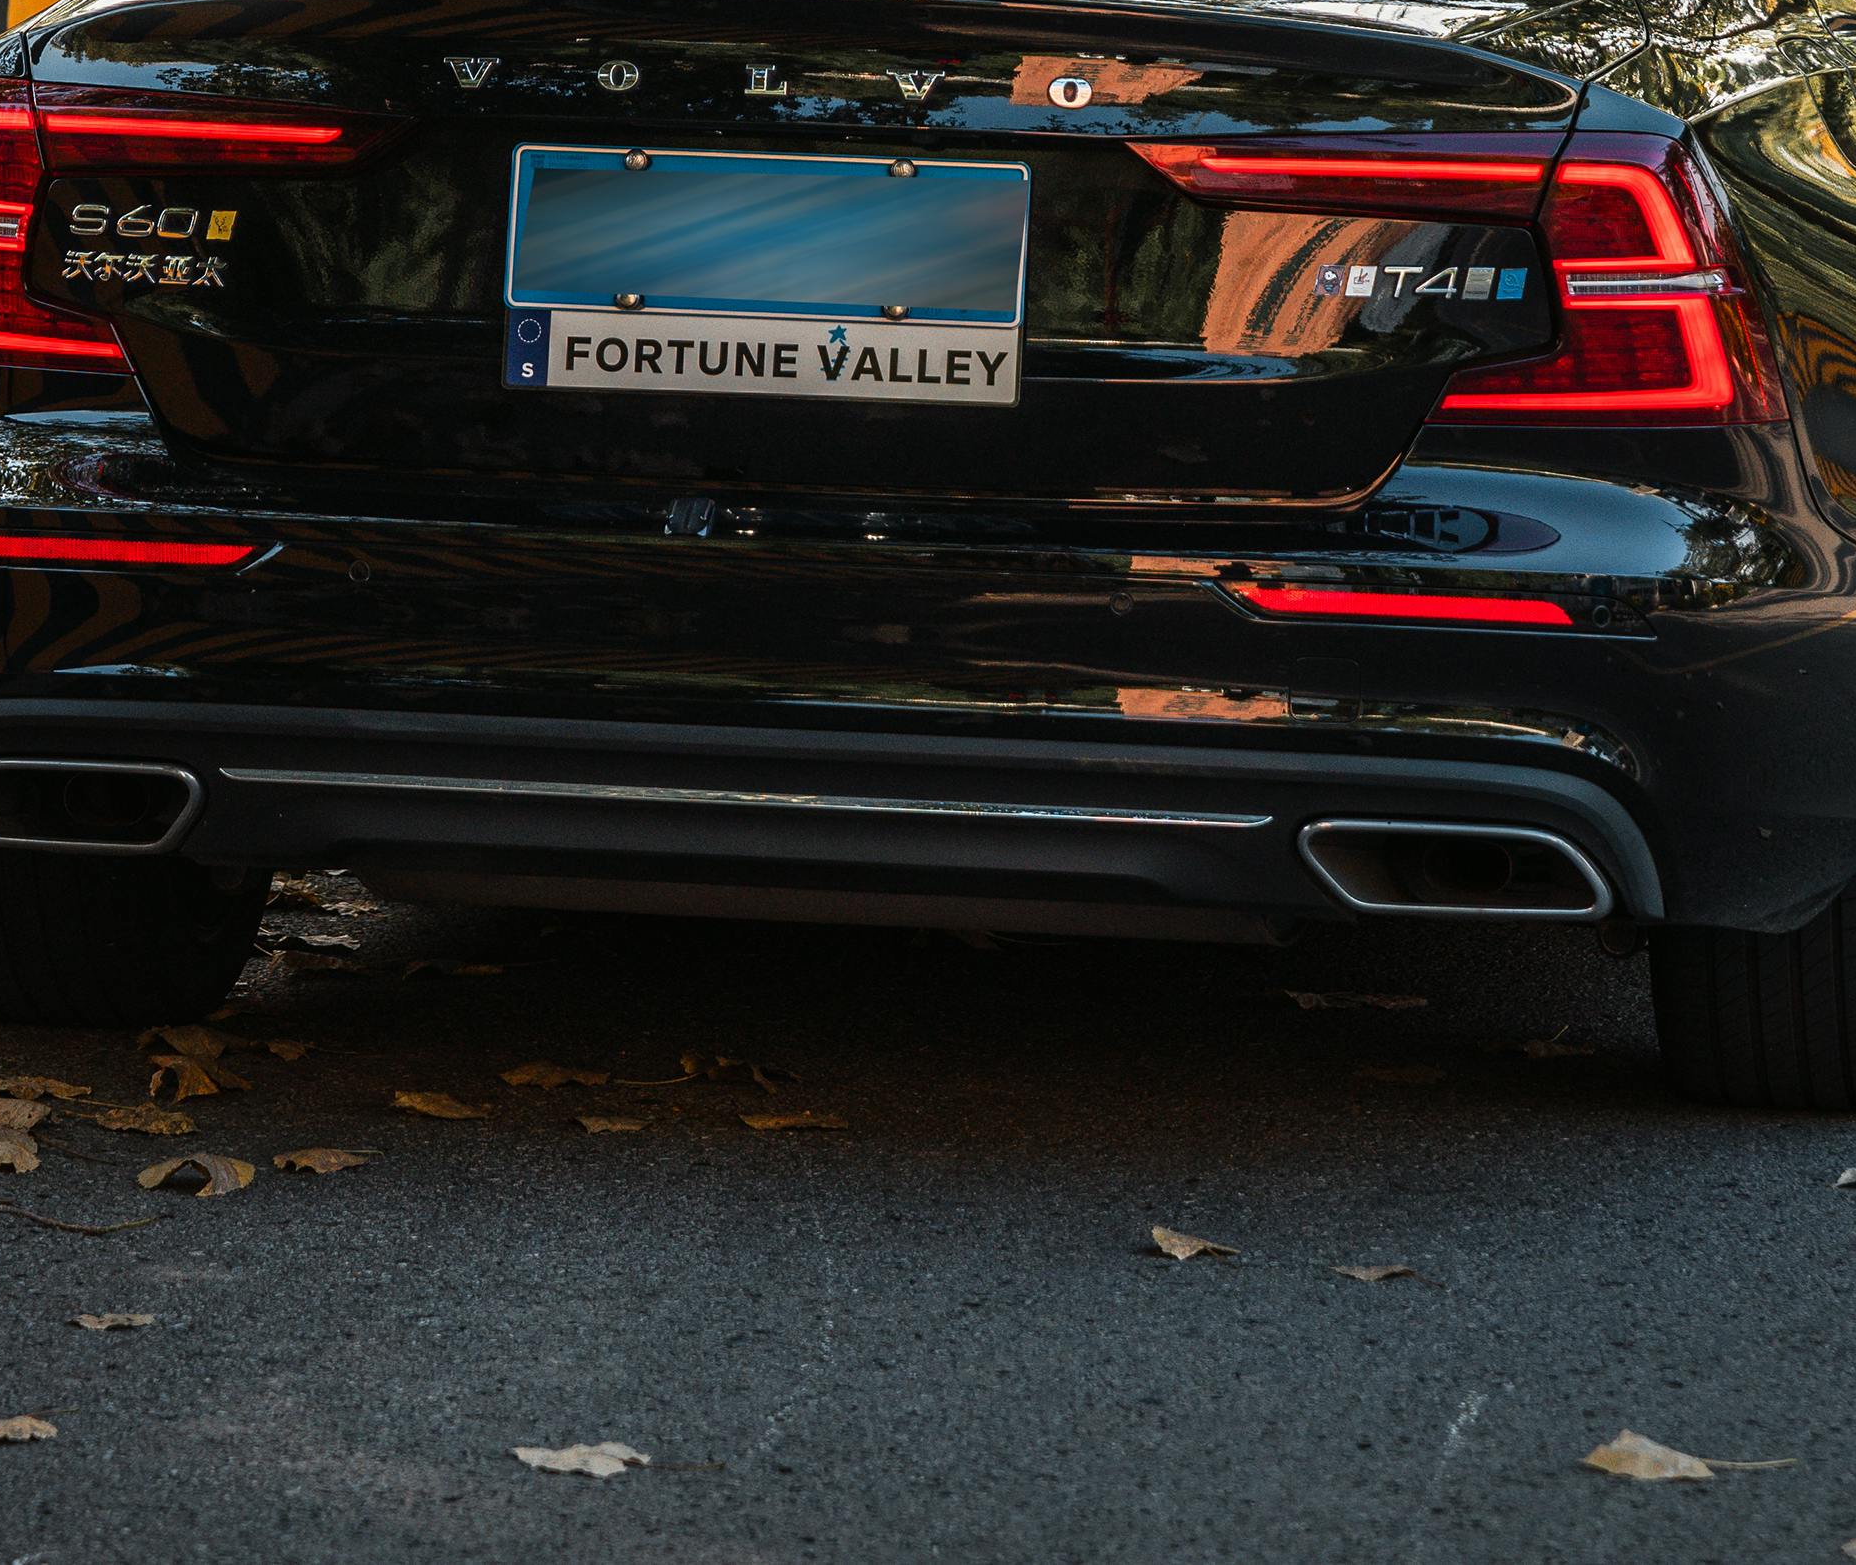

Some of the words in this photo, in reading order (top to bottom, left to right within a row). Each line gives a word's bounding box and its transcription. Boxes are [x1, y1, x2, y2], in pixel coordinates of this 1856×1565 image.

[443, 56, 1093, 109] VOLVO
[69, 203, 199, 238] S60
[61, 250, 228, 287] 沃尔沃亚太
[1384, 266, 1458, 299] T4
[521, 362, 534, 378] S
[565, 336, 799, 379] FORTUNE
[817, 344, 1009, 386] VALLEY
